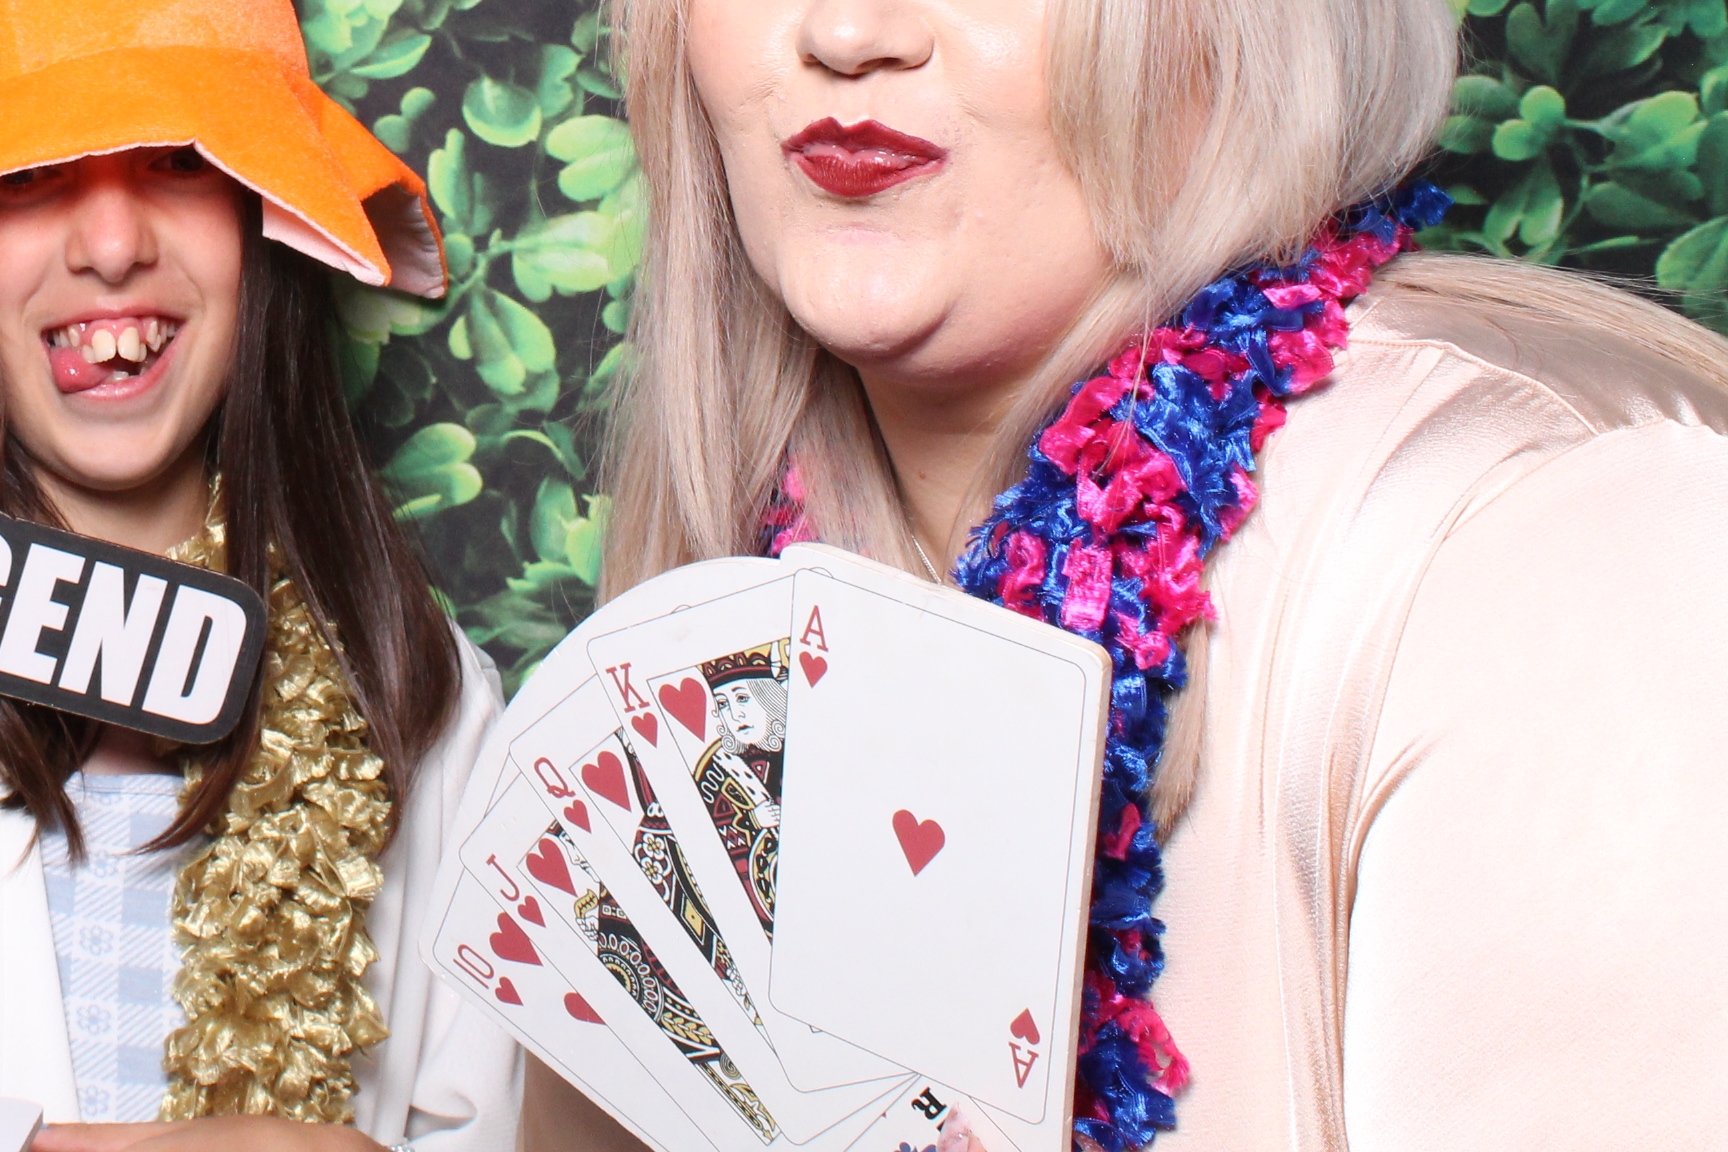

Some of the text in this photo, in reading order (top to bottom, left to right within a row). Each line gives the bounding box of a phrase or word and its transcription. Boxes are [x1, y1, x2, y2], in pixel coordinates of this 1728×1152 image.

[800, 605, 829, 652] A
[605, 662, 650, 713] K
[533, 757, 576, 798] Q
[486, 853, 520, 901] J
[453, 944, 495, 989] 10
[1008, 1041, 1039, 1089] A
[911, 1086, 947, 1132] R
